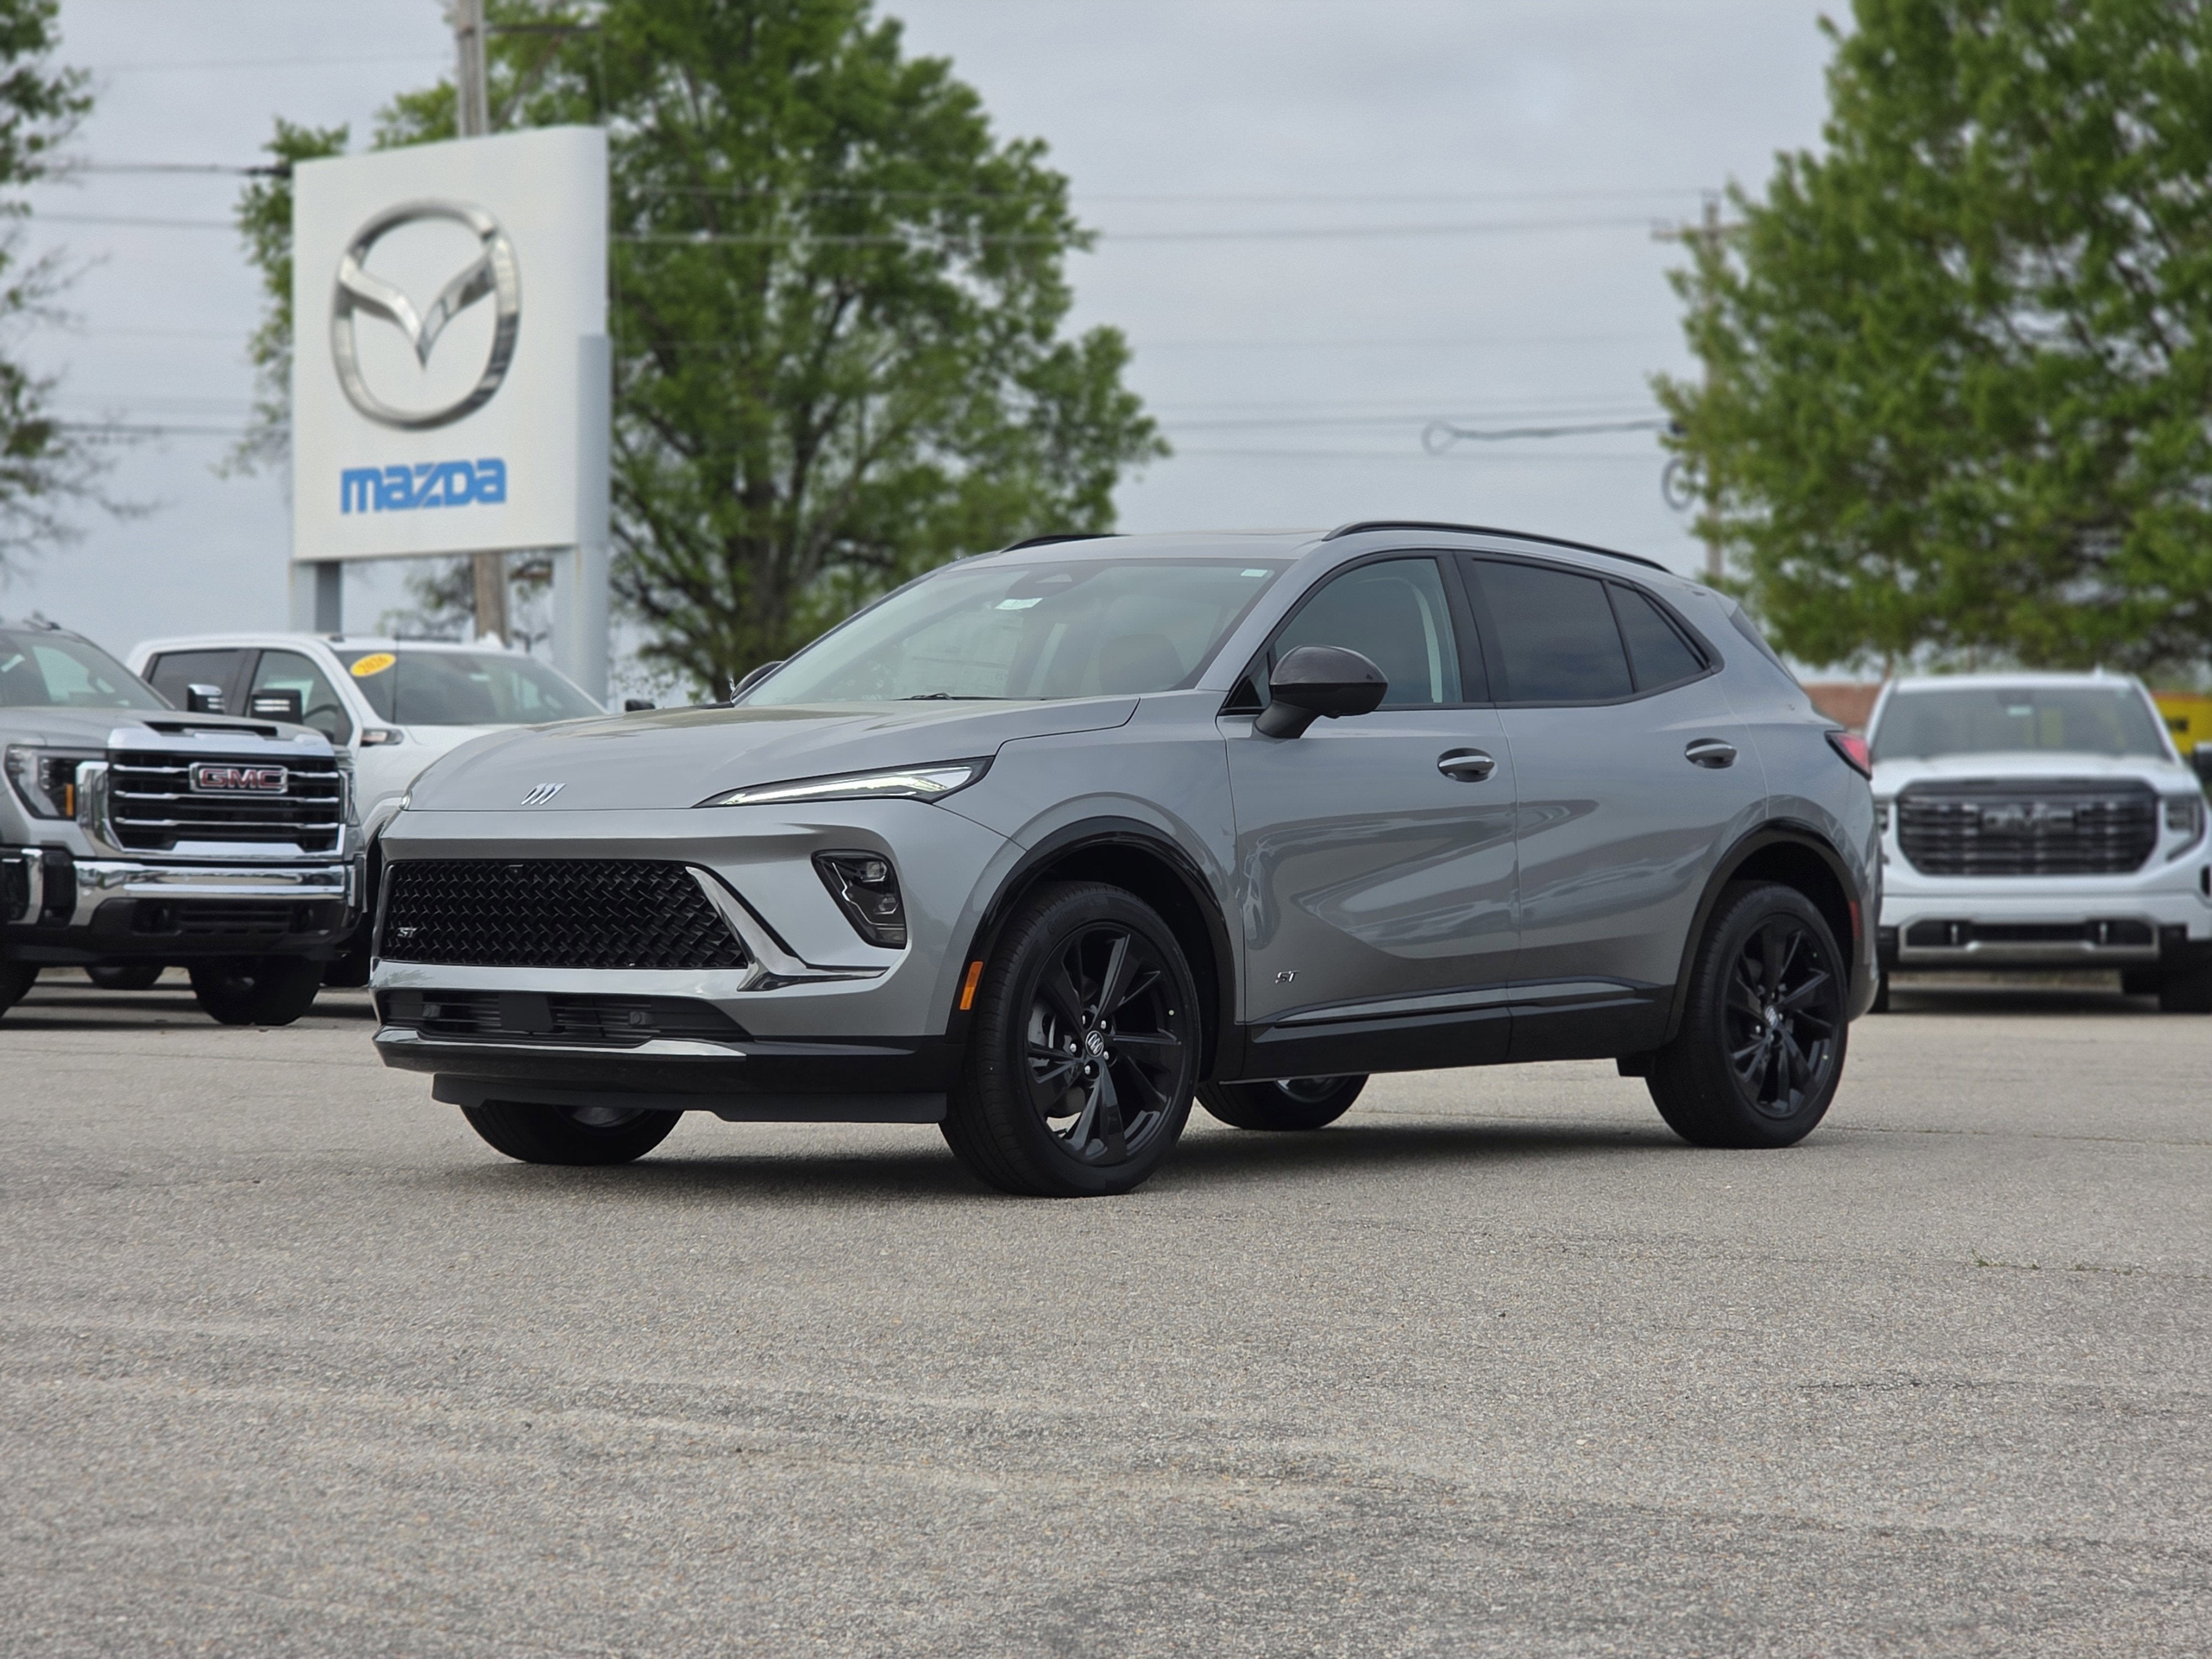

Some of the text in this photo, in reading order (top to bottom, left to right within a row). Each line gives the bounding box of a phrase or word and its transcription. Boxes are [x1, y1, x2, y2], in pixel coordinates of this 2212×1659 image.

[199, 768, 286, 789] GMC
[397, 927, 417, 938] ST
[1275, 970, 1300, 984] ST
